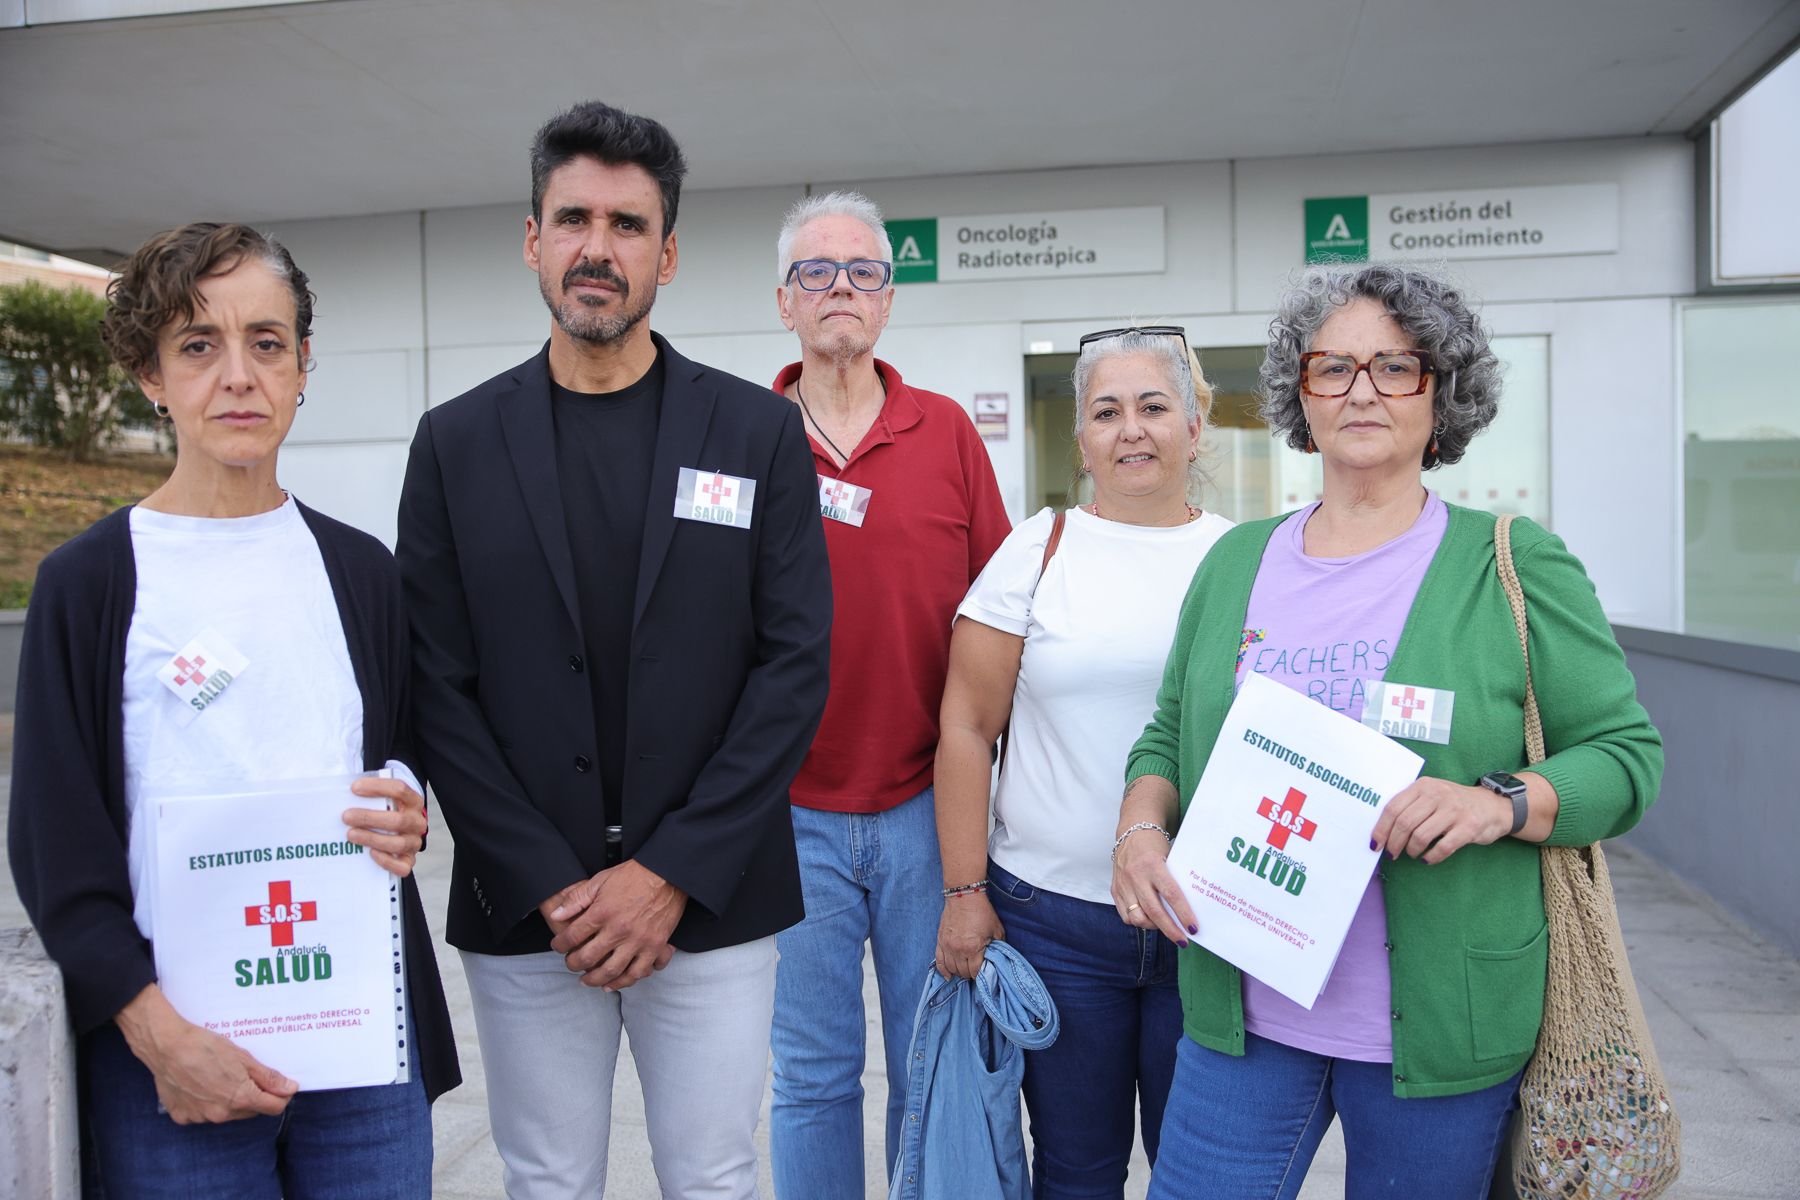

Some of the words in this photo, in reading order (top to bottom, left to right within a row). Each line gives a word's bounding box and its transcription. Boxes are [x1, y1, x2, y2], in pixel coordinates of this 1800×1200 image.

[1389, 201, 1472, 225] Gestión
[1478, 200, 1512, 220] del
[957, 221, 1058, 246] Oncología
[1389, 228, 1544, 250] Conocimiento
[957, 246, 1097, 270] Radioterápica
[694, 505, 734, 523] SALUD
[820, 504, 848, 521] ALUD
[190, 670, 234, 711] SALUD
[1382, 720, 1427, 738] SALUD
[1243, 728, 1307, 770] ESTATUTOS
[1305, 761, 1381, 807] ASOCIACIÓN
[1268, 803, 1305, 834] S.O.S
[189, 848, 272, 870] ESTATUTOS
[1226, 836, 1307, 897] SALUD
[1266, 846, 1307, 873] Andalucía
[259, 903, 303, 924] S.O.S
[1189, 870, 1200, 880] Por
[1201, 877, 1208, 885] la
[1208, 881, 1237, 901] defensa
[1238, 897, 1247, 906] de
[1248, 903, 1274, 921] nuestro
[1275, 918, 1309, 941] DERECHO
[1191, 883, 1205, 893] una
[1205, 889, 1237, 911] SANIDAD
[1238, 907, 1266, 928] PÚBLICA
[1267, 924, 1305, 950] UNIVERSAL
[277, 943, 327, 956] Andalucía
[234, 953, 332, 987] SALUD
[232, 1018, 269, 1027] defensa
[271, 1015, 283, 1023] de
[285, 1012, 318, 1022] nuestro
[320, 1008, 361, 1019] DERECHO
[233, 1027, 274, 1038] SANIDAD
[277, 1022, 313, 1033] PÚBLICA
[315, 1019, 362, 1031] UNIVERSAL
